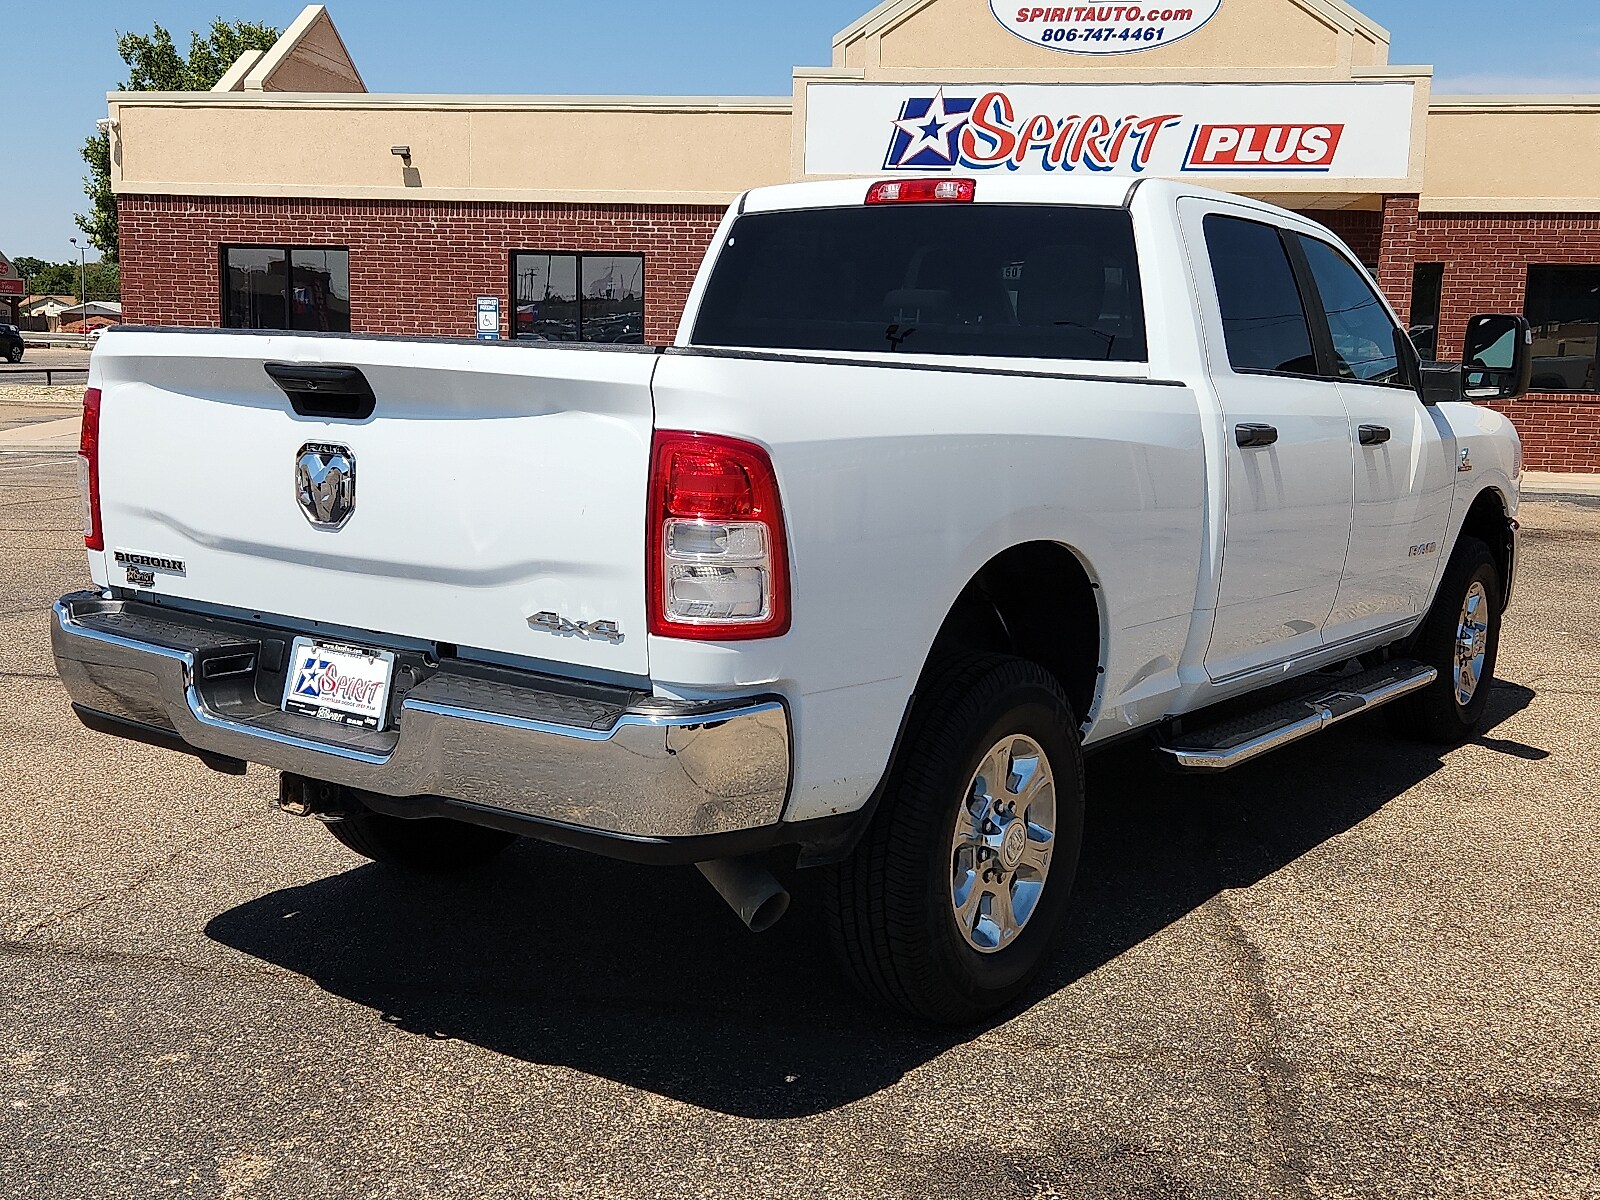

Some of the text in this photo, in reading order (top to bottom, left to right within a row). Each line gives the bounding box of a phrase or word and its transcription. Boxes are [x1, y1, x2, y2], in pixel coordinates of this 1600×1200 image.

[1015, 6, 1193, 23] SPIRITAUTO.com
[1041, 27, 1165, 42] 806-747-4461
[959, 91, 1334, 171] SPIRIT PLUS
[319, 664, 385, 704] SPIRIT
